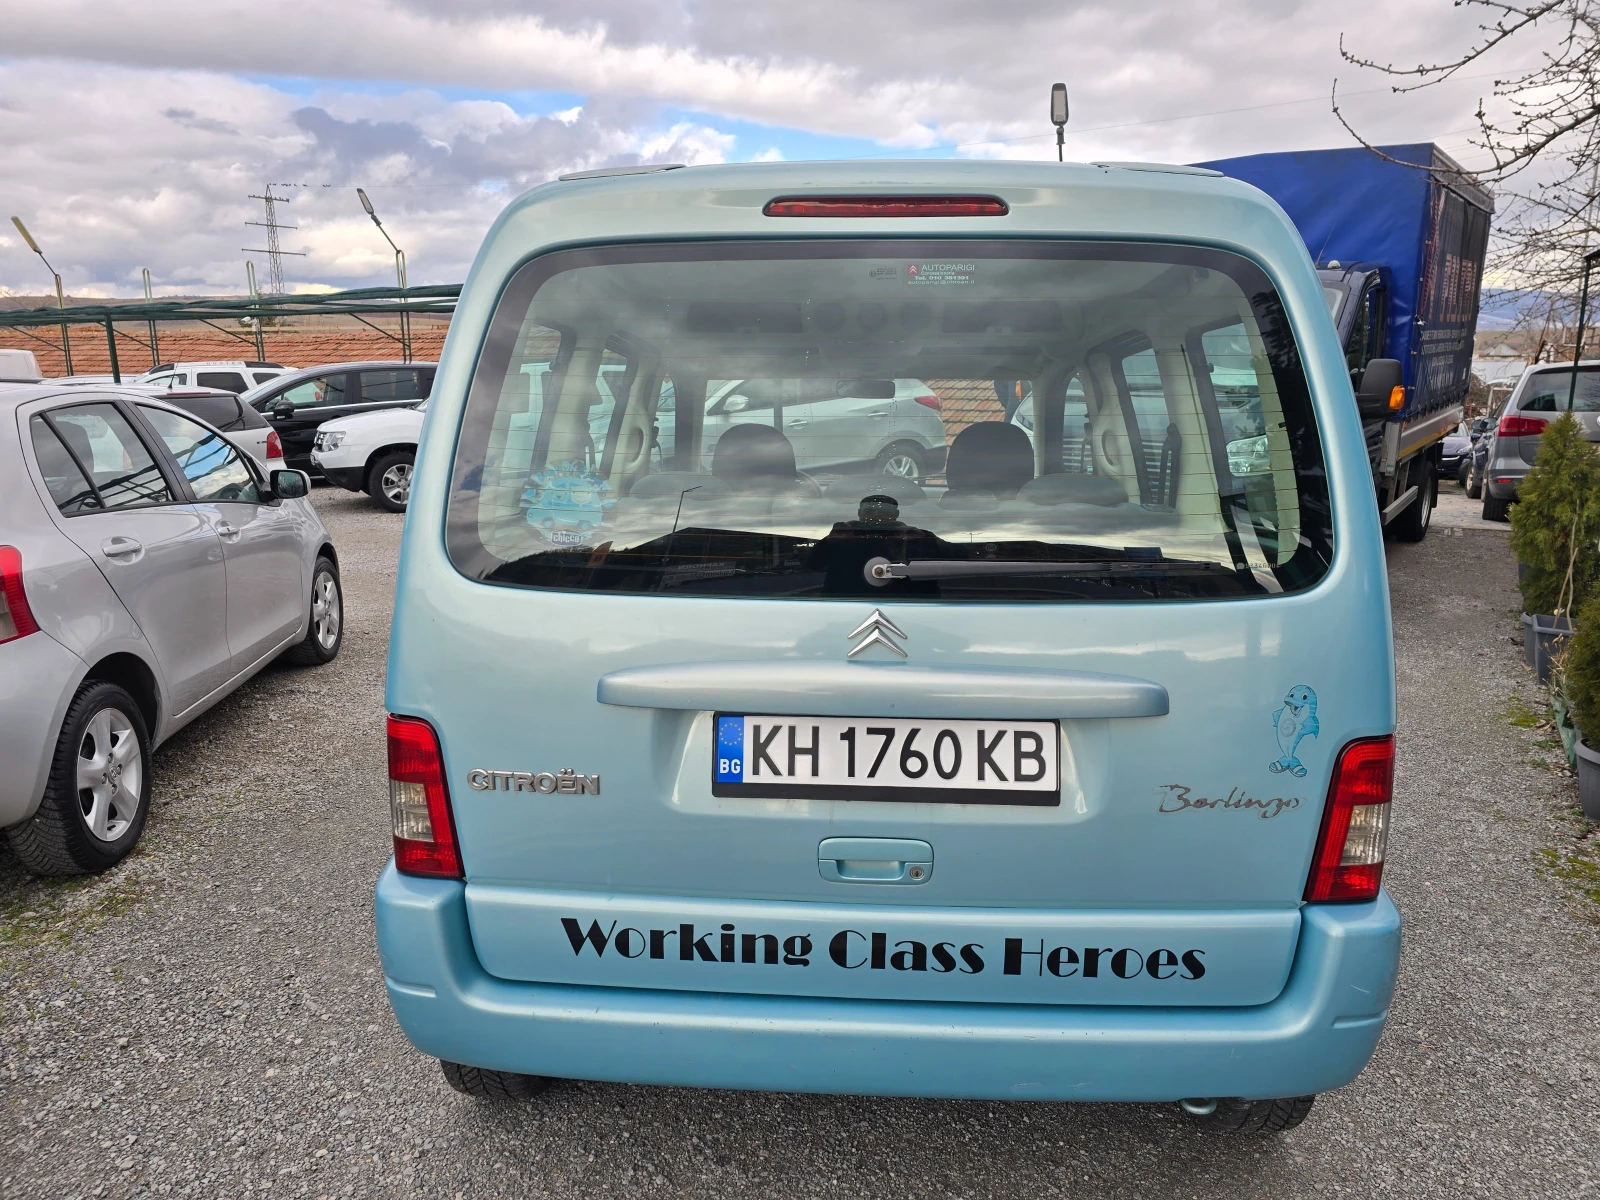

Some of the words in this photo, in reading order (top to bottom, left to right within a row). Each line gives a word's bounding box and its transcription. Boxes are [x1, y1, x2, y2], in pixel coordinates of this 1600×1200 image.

[719, 758, 741, 774] BG
[752, 724, 820, 777] KH
[840, 726, 962, 780] 1760
[977, 729, 1047, 782] KB
[467, 768, 599, 795] CITROËN
[1153, 784, 1307, 819] Berlingo
[560, 917, 813, 967] Working
[829, 929, 985, 974] Class
[1003, 937, 1206, 980] Heroes
